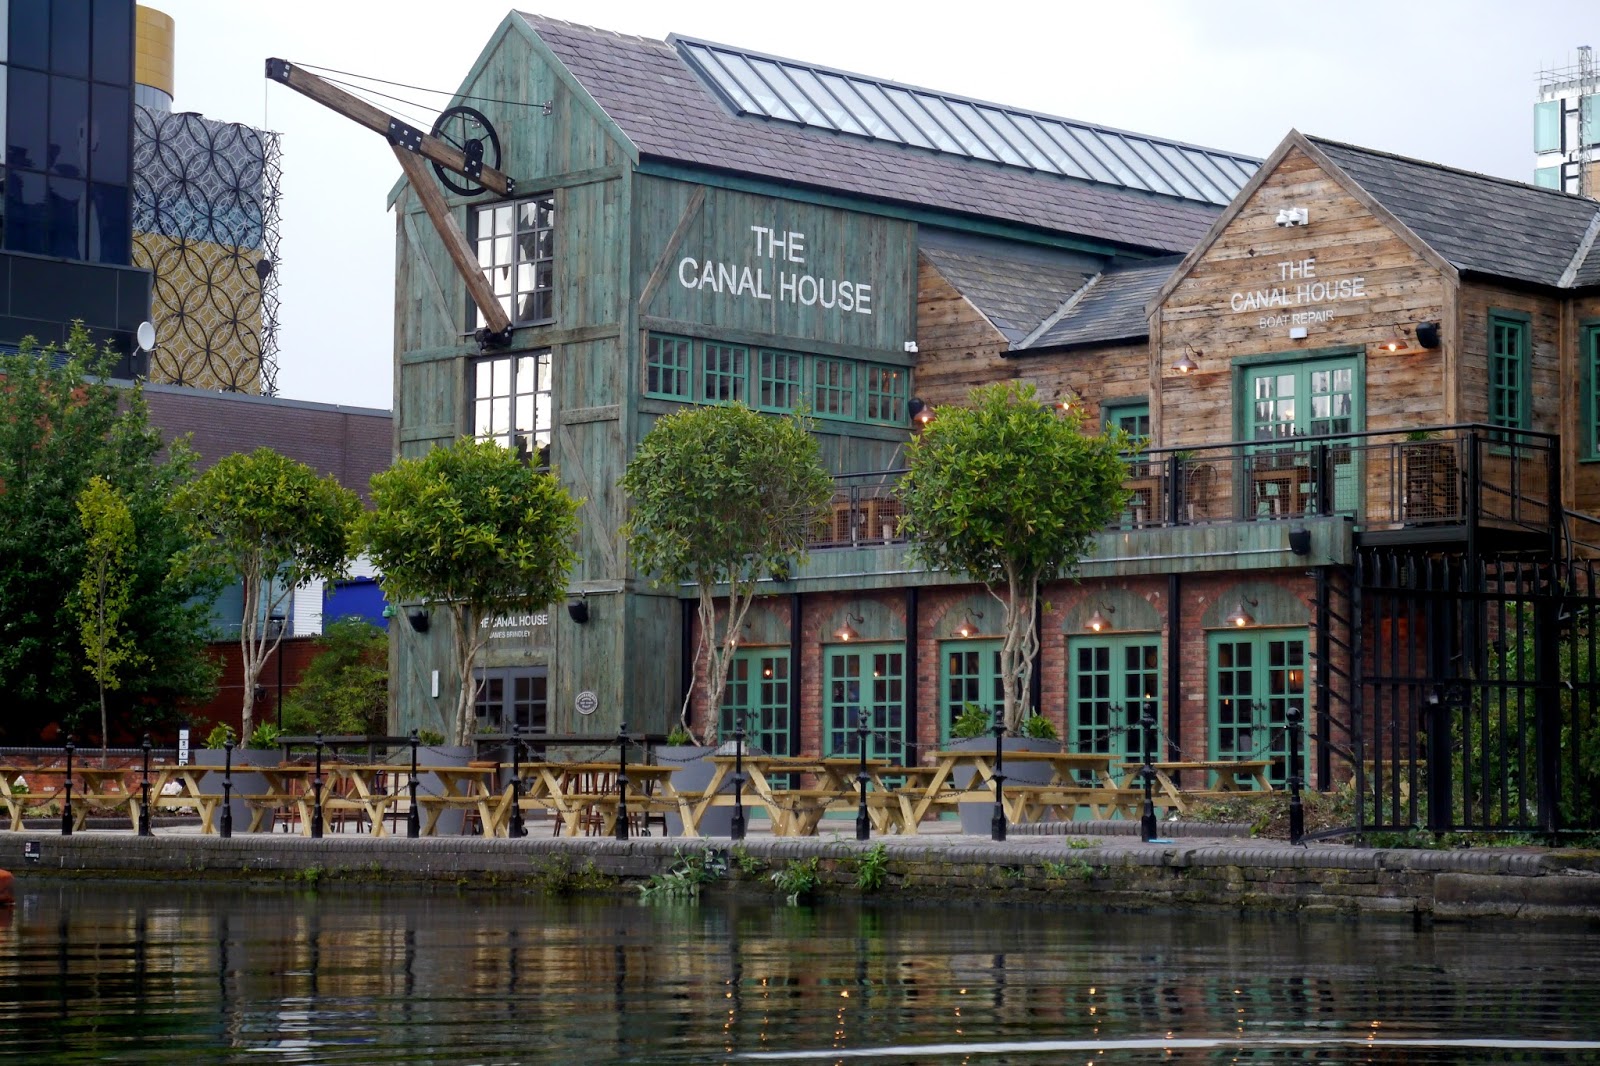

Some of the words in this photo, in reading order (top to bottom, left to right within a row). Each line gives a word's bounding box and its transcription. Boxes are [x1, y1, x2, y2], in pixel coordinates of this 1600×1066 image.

[751, 225, 805, 263] THE
[1278, 258, 1316, 280] THE
[678, 257, 772, 300] CANAL
[780, 271, 872, 315] HOUSE
[1230, 287, 1293, 312] CANAL
[1297, 277, 1366, 304] HOUSE
[1259, 315, 1291, 329] BOAT
[1292, 309, 1335, 325] REPAIR
[519, 614, 548, 626] HOUSE
